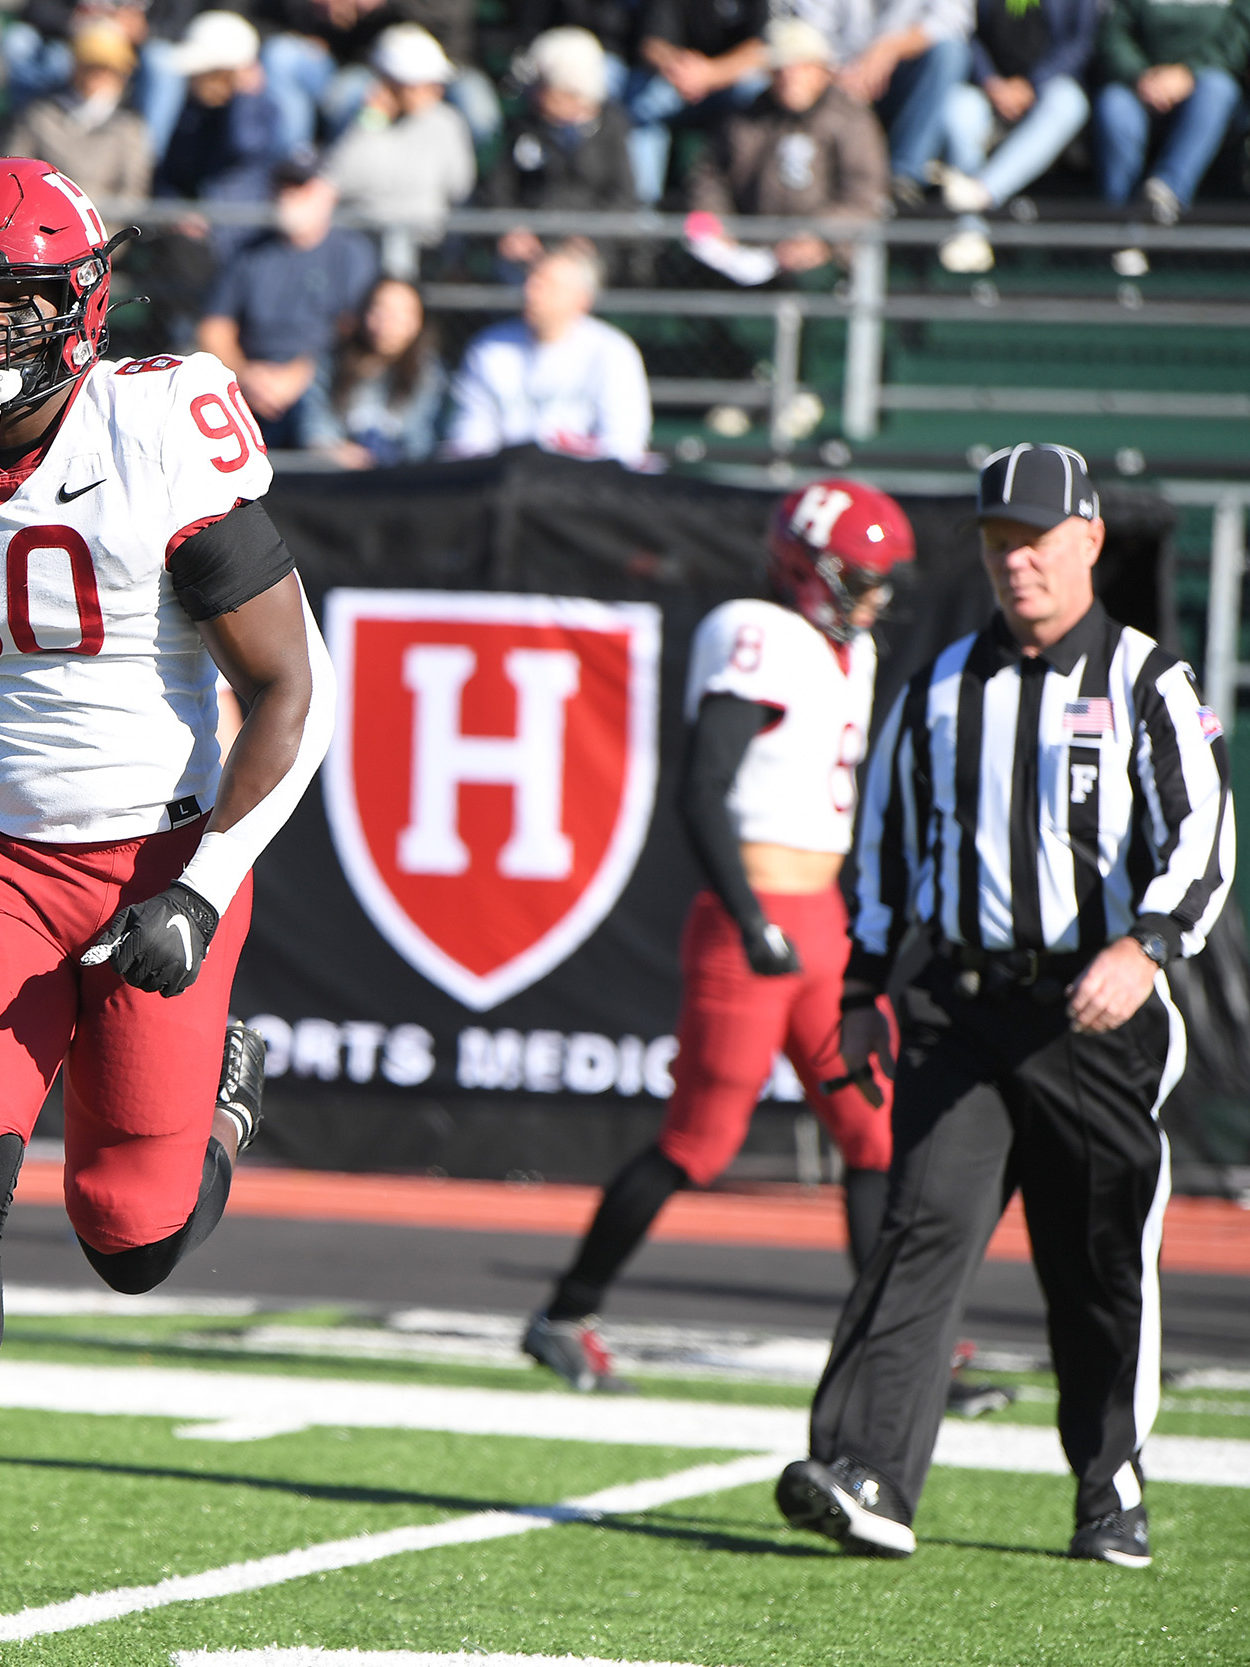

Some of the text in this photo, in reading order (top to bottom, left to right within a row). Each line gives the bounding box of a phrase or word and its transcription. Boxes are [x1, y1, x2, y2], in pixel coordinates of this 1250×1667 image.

[42, 171, 109, 247] H
[790, 485, 853, 549] H
[730, 623, 763, 672] 8
[395, 640, 582, 882] H
[828, 722, 862, 813] 8
[1069, 763, 1098, 804] F
[179, 804, 189, 815] L
